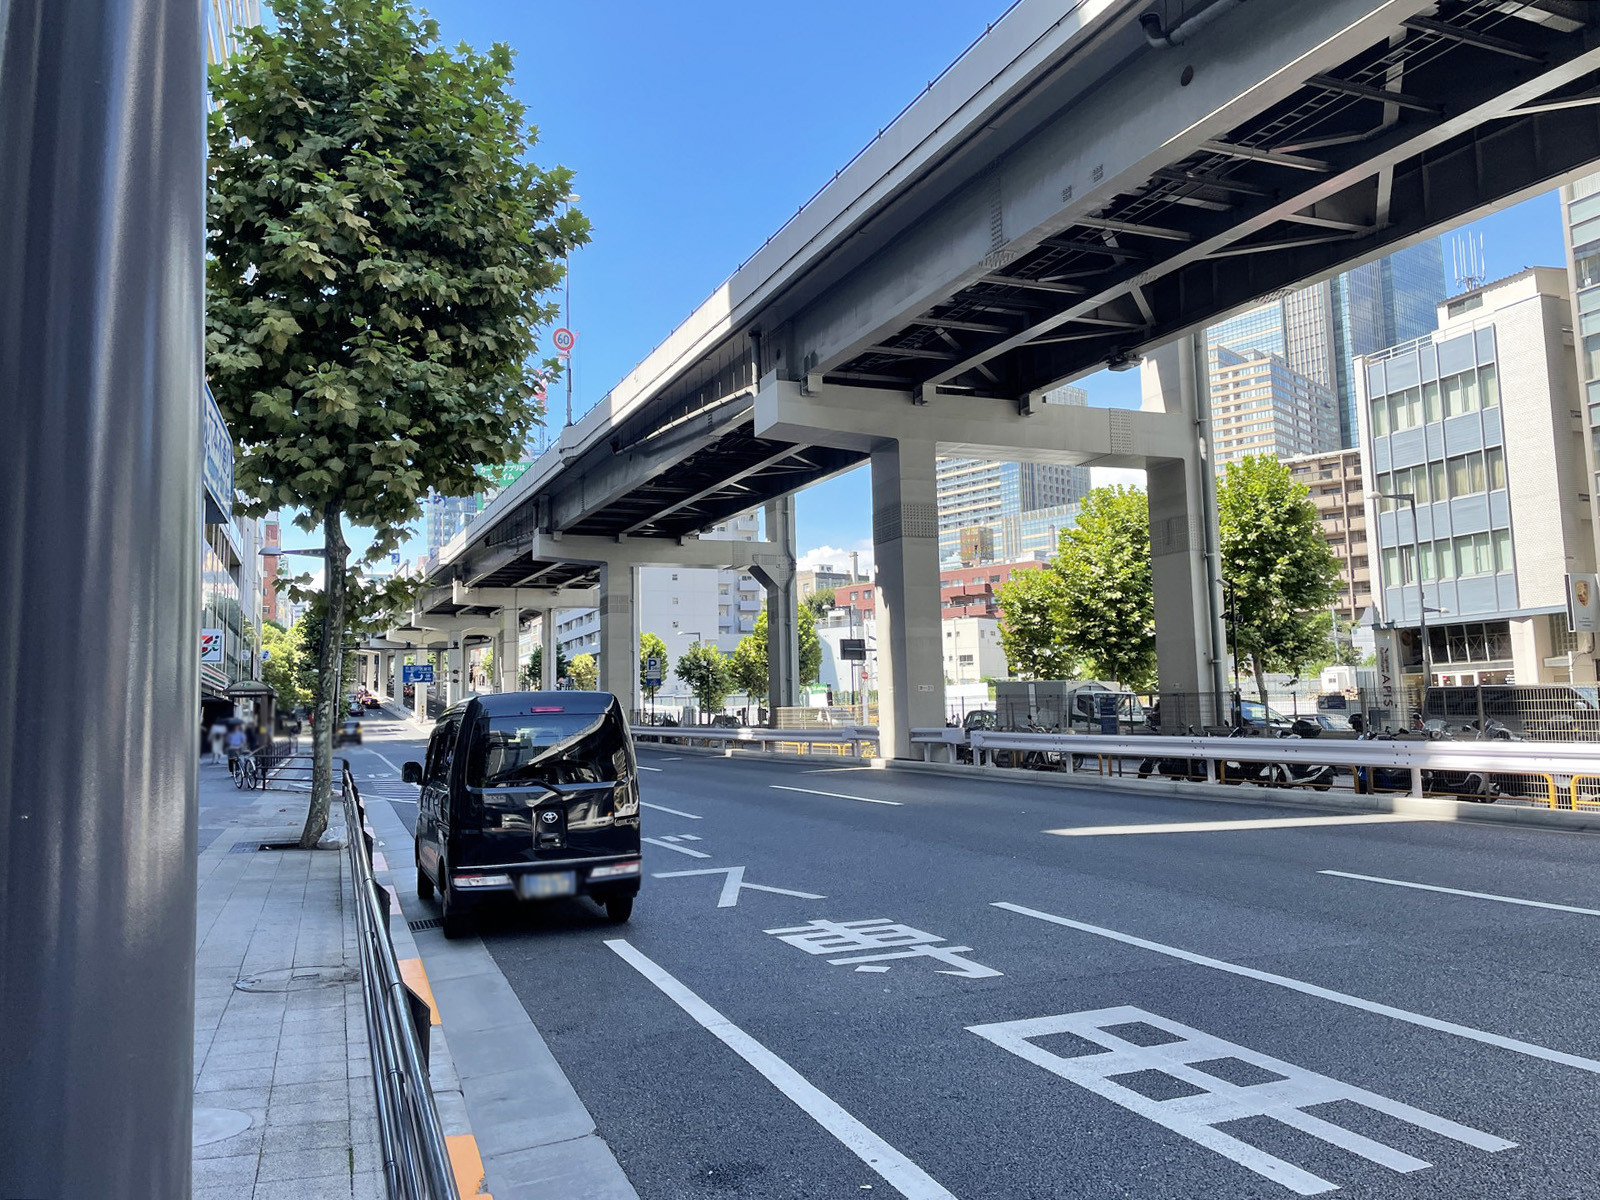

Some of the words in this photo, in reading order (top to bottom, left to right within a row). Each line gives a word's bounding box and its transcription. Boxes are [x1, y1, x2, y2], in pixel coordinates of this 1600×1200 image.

[557, 334, 570, 345] 60
[480, 464, 525, 473] カーアプリは
